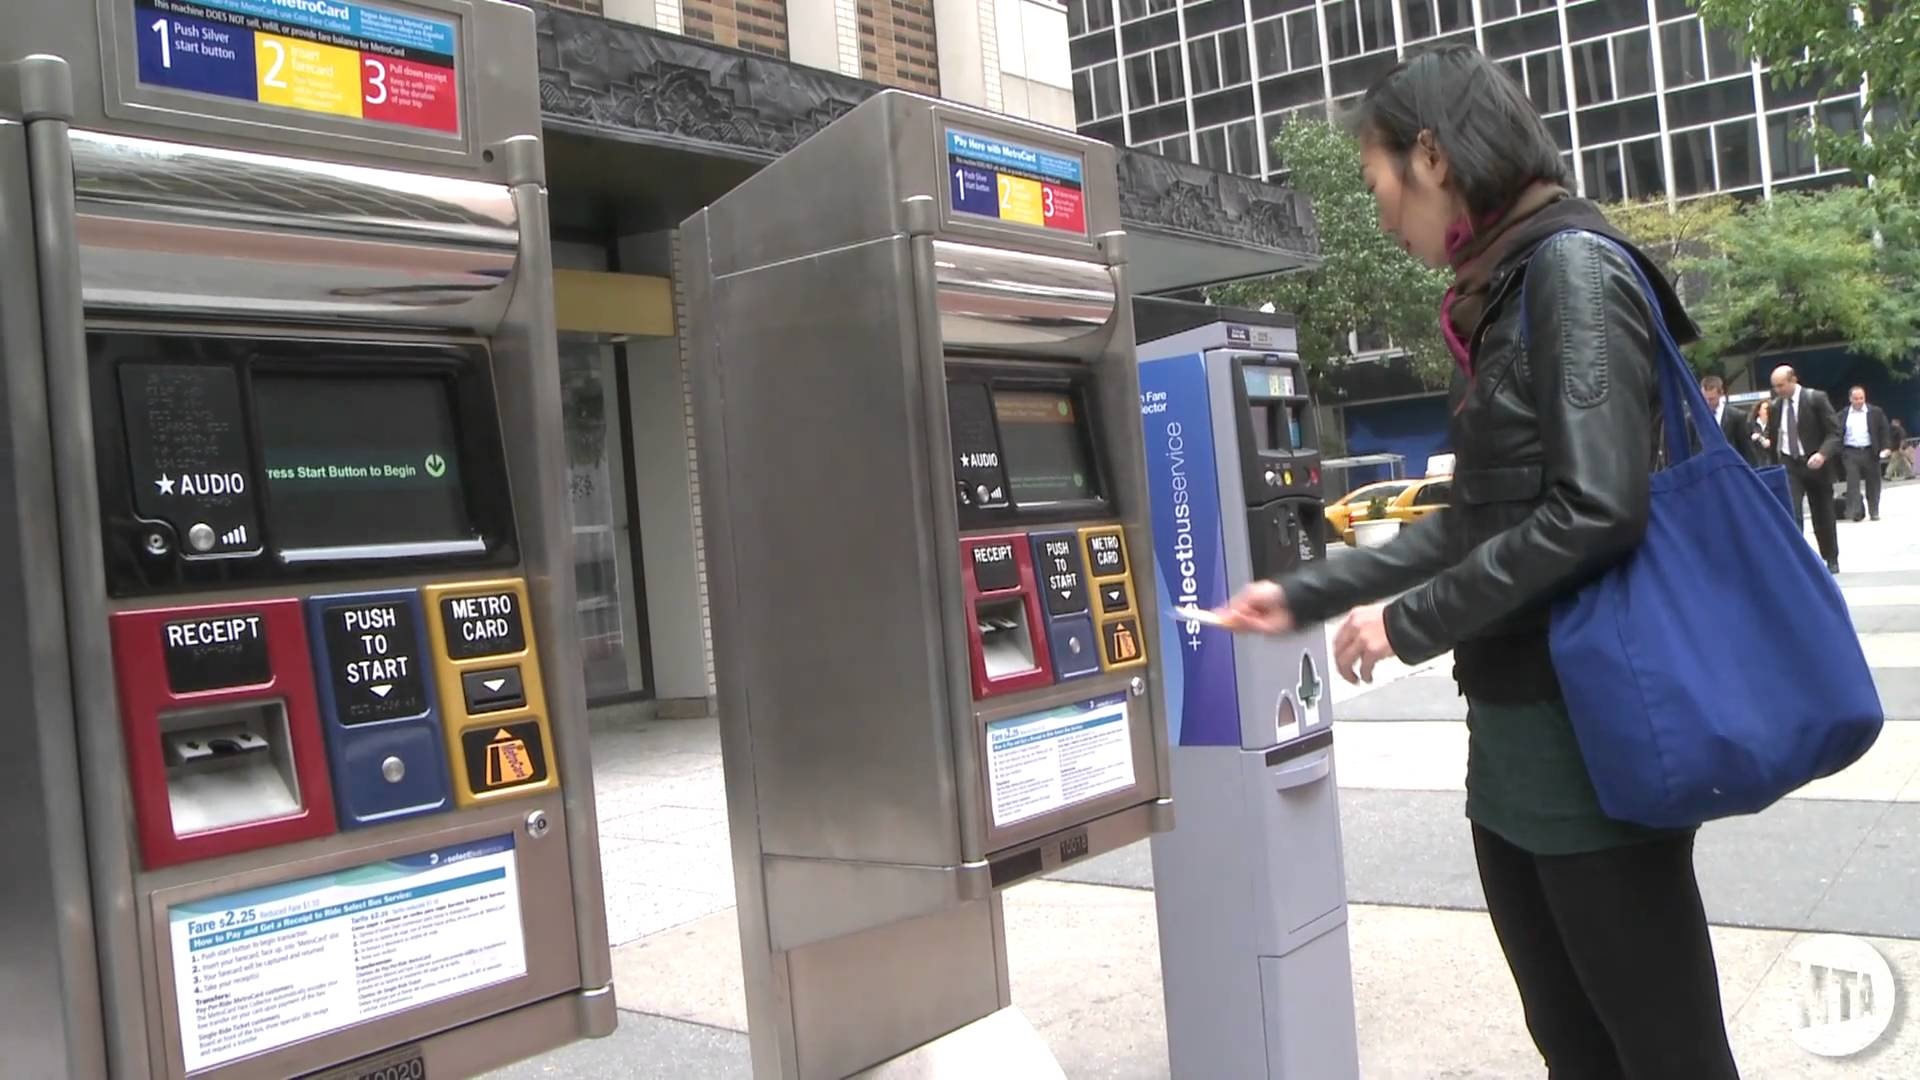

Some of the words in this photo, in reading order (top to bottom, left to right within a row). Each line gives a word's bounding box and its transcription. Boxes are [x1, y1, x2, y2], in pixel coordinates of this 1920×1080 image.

[154, 0, 169, 9] This
[171, 3, 204, 17] machine
[205, 9, 227, 22] DOES
[228, 14, 245, 25] NOT
[291, 27, 317, 40] provide
[318, 31, 332, 42] fare
[333, 35, 358, 48] balance
[360, 40, 370, 49] for
[370, 41, 405, 56] MetroCard
[174, 22, 200, 37] Push
[202, 27, 229, 43] Silver
[152, 18, 170, 68] 1
[175, 40, 199, 54] start
[201, 43, 235, 60] button
[262, 40, 288, 88] 2
[390, 63, 403, 74] Pull
[404, 67, 424, 78] down
[424, 71, 447, 84] receipt
[365, 59, 388, 104] 3
[953, 135, 967, 148] Pay
[968, 138, 985, 151] Here
[987, 143, 1001, 152] with
[1002, 146, 1036, 162] MetroCard
[955, 169, 965, 200] 1
[1001, 178, 1012, 209] 2
[1043, 187, 1056, 217] 3
[1146, 391, 1167, 402] Fare
[971, 453, 998, 467] AUDIO
[265, 466, 295, 479] ress
[297, 466, 326, 478] Start
[329, 465, 367, 478] Button
[369, 465, 382, 477] to
[384, 464, 416, 479] Begin
[180, 473, 245, 496] AUDIO
[973, 545, 1012, 562] RECEIPT
[1046, 542, 1070, 556] PUSH
[1092, 536, 1119, 550] METRO
[1055, 558, 1067, 572] TO
[1097, 552, 1118, 565] CARD
[1050, 573, 1077, 590] START
[451, 595, 511, 620] METRO
[344, 608, 396, 631] PUSH
[462, 617, 509, 641] CARD
[167, 616, 259, 648] RECEIPT
[361, 634, 387, 656] TO
[347, 656, 409, 683] START
[188, 919, 216, 935] Fare
[219, 909, 256, 928] $2.25
[193, 935, 214, 948] How
[215, 934, 224, 944] to
[226, 931, 242, 943] Pay
[243, 926, 259, 937] and
[260, 921, 276, 932] Get
[276, 921, 283, 930] a
[283, 914, 314, 929] Receipt
[315, 911, 323, 920] to
[325, 906, 342, 917] Ride
[343, 900, 367, 912] Select
[368, 897, 383, 908] Bus
[191, 954, 200, 964] 1.
[201, 952, 216, 960] Push
[217, 948, 231, 957] start
[232, 944, 251, 953] button
[260, 937, 276, 948] begin
[191, 965, 201, 975] 2.
[202, 961, 220, 971] Insert
[221, 958, 234, 968] your
[192, 975, 202, 985] 3.
[203, 973, 217, 982] Your
[218, 965, 242, 977] farecard
[243, 961, 254, 971] will
[255, 960, 263, 969] be
[264, 954, 289, 967] captured
[289, 949, 301, 960] and
[301, 945, 325, 957] returned
[193, 986, 203, 995] 4.
[203, 984, 217, 992] Take
[219, 980, 231, 990] your
[233, 991, 264, 1004] MetroCard
[195, 992, 231, 1006] Transfers:
[363, 1060, 422, 1080] 020
